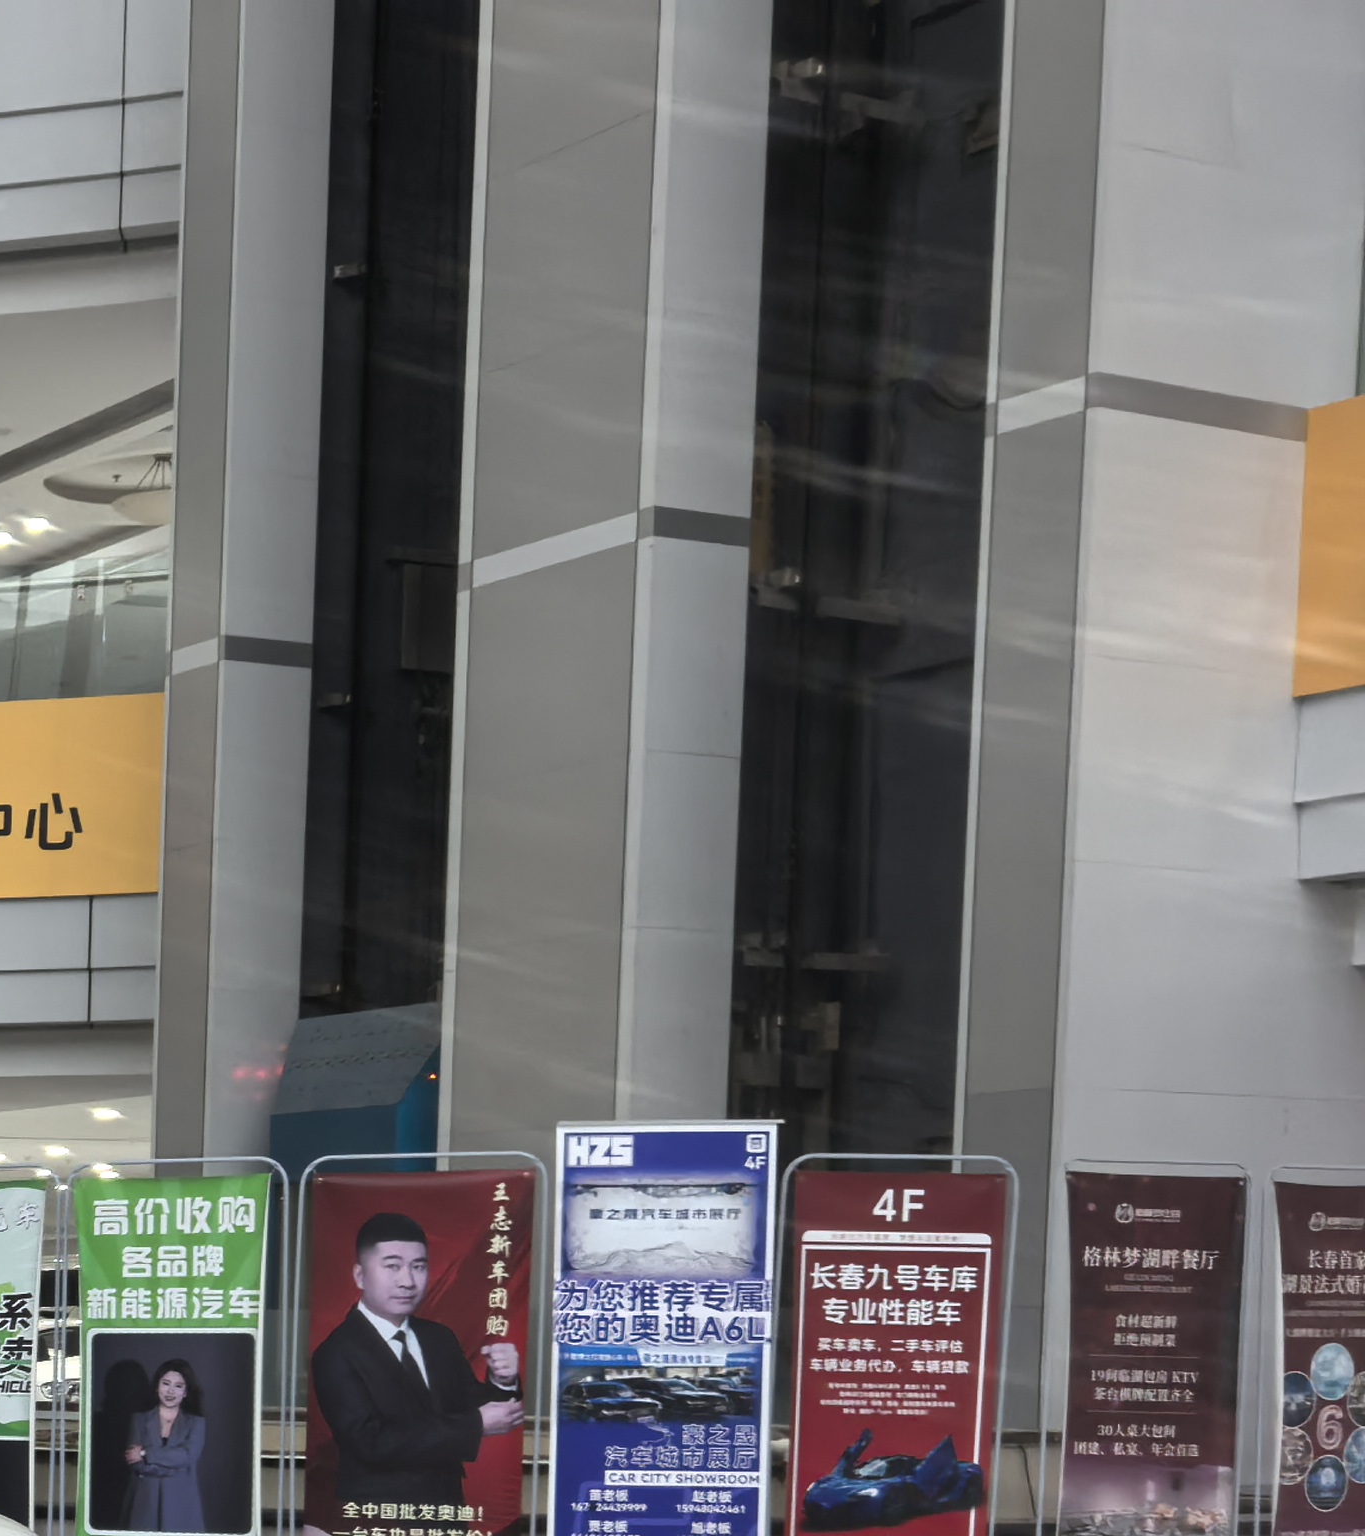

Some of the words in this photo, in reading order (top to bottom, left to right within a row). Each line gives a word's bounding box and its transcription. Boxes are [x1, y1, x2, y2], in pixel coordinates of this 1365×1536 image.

[567, 1135, 634, 1167] HZS
[744, 1156, 767, 1169] 4F
[93, 1196, 257, 1236] 高价收购
[873, 1189, 925, 1222] 4F
[121, 1245, 225, 1278] 各品牌
[1082, 1246, 1220, 1270] 格林梦湖畔餐厅
[810, 1263, 979, 1292] 长春九号车库
[86, 1287, 261, 1320] 新能源汽车
[557, 1281, 765, 1312] 为您推荐专属
[822, 1298, 962, 1327] 专业性能车
[558, 1313, 768, 1344] 您的奥迪A6L
[1172, 1371, 1200, 1384] KTV
[604, 1445, 758, 1469] 汽车城市展厅
[608, 1473, 636, 1483] CAR
[641, 1474, 671, 1484] CITY
[676, 1474, 760, 1485] SHOWROOM
[342, 1502, 484, 1522] 全中国批发奥迪！
